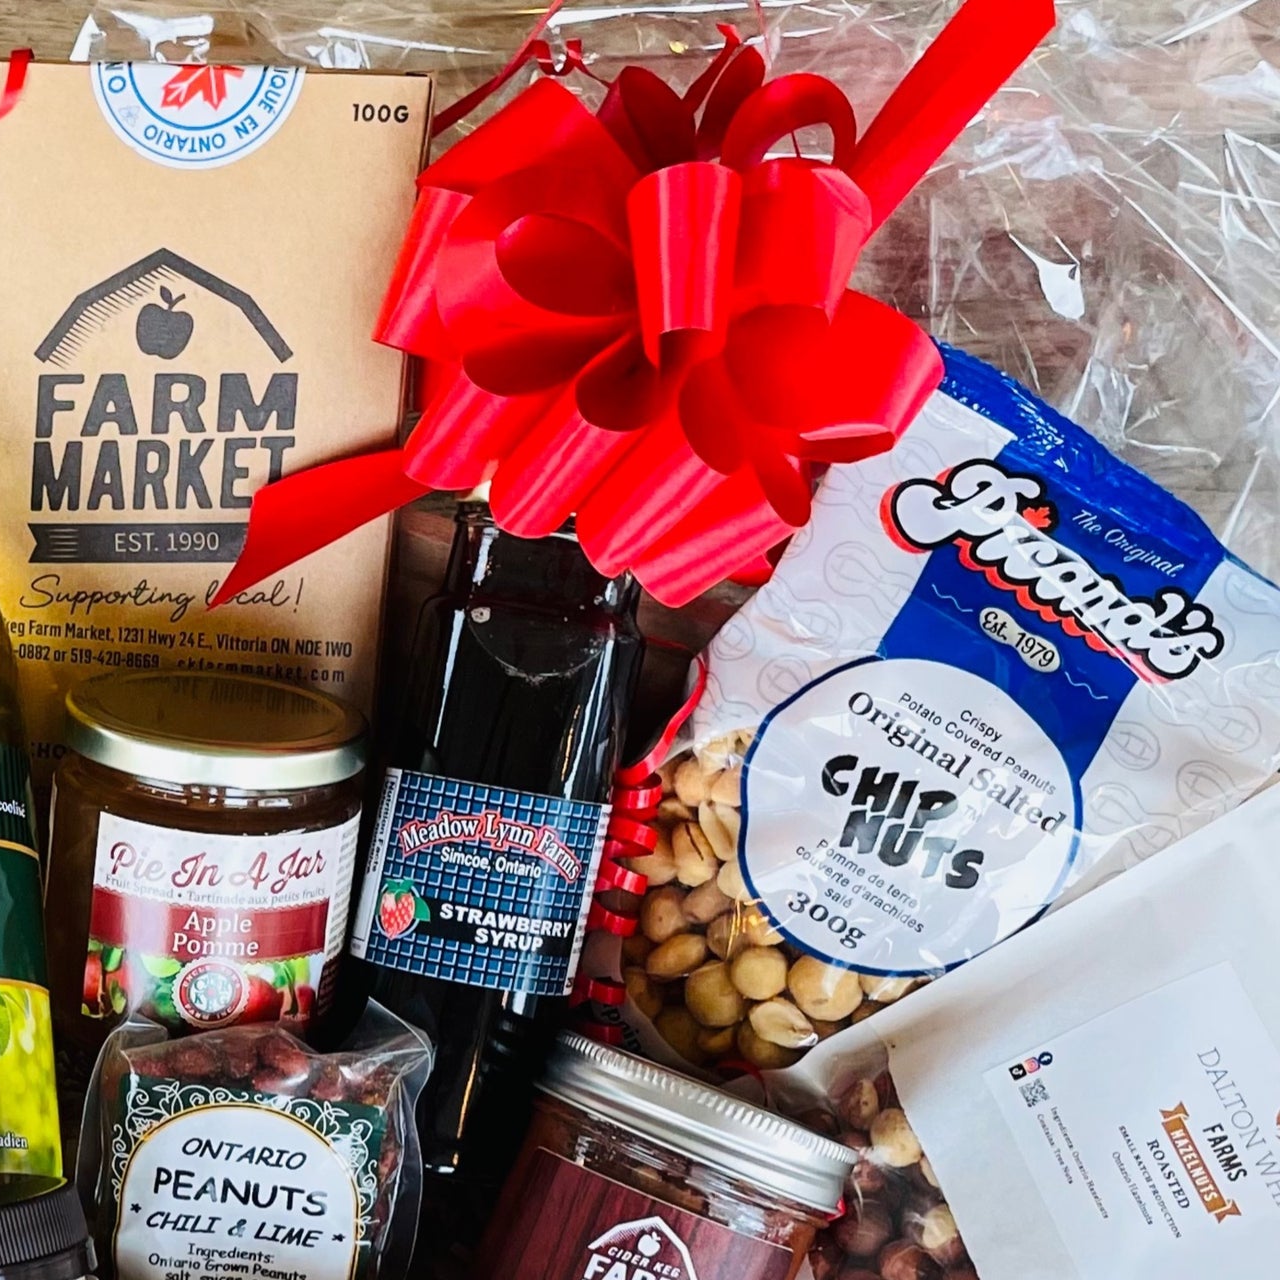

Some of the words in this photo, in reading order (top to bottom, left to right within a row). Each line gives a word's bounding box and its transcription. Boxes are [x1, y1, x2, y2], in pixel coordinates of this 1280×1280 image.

[233, 114, 259, 139] EN
[352, 103, 409, 123] 100G
[144, 125, 226, 153] ONTARIO
[35, 373, 299, 438] FARM
[30, 436, 295, 511] MARKET
[115, 533, 159, 553] EST.
[167, 531, 219, 552] 1990
[1072, 509, 1100, 535] The
[1104, 528, 1185, 578] Original
[892, 460, 1224, 678] Picard's
[20, 574, 195, 622] Supporting
[29, 620, 61, 637] Farm
[65, 623, 114, 642] Market,
[118, 627, 144, 643] 1231
[149, 630, 176, 648] Hwy
[179, 632, 194, 647] 24
[217, 634, 267, 653] Vittoria
[272, 638, 289, 654] ON
[54, 650, 67, 661] or
[71, 648, 159, 668] 519-420-8669
[982, 611, 1007, 641] Est.
[1015, 632, 1055, 668] 1979
[898, 692, 942, 726] Potato
[945, 721, 1002, 762] Covered
[1003, 755, 1057, 796] Peanuts
[960, 709, 1003, 742] Crispy
[848, 691, 972, 779] Original
[970, 767, 1067, 836] Salted
[821, 754, 958, 829] CHIP
[110, 842, 166, 880] Pie
[171, 852, 223, 888] In
[229, 850, 269, 890] A
[270, 847, 327, 894] Jar
[401, 814, 479, 852] Meadow
[485, 813, 535, 847] Lynn
[536, 830, 580, 881] Farms
[441, 846, 491, 872] Simcoe,
[495, 856, 541, 878] Ontario
[839, 809, 985, 889] NUTS
[105, 875, 129, 890] Fruit
[133, 882, 174, 899] Spread
[187, 890, 244, 904] Tartinade
[247, 895, 268, 905] aux
[271, 892, 300, 907] petits
[302, 887, 326, 899] fruits
[796, 846, 850, 887] couverte
[852, 885, 924, 933] d'arachides
[816, 839, 866, 876] Pomme
[868, 875, 884, 888] de
[887, 884, 918, 908] terre
[440, 903, 572, 938] STRAWBERRY
[788, 892, 866, 949] 300g
[824, 888, 853, 908] salé
[172, 933, 259, 956] Pomme
[184, 911, 253, 937] Apple
[475, 928, 543, 951] SYRUP
[1197, 1047, 1267, 1150] DALTON
[182, 1138, 307, 1170] ONTARIO
[1113, 1151, 1131, 1183] Ontario
[1147, 1139, 1190, 1209] ROASTED
[1170, 1129, 1218, 1202] HAZELNUTS
[1203, 1123, 1247, 1182] FARMS
[154, 1167, 328, 1216] PEANUTS
[1119, 1125, 1137, 1153] SMALL
[1149, 1183, 1182, 1239] PRODUCTION
[146, 1211, 221, 1234] CHILI
[227, 1219, 247, 1238] &
[254, 1222, 324, 1248] LIME
[188, 1243, 274, 1264] Ingredients:
[148, 1253, 200, 1270] Ontario
[205, 1259, 249, 1274] Grown
[608, 1247, 650, 1267] CIDER
[653, 1262, 680, 1278] KEG
